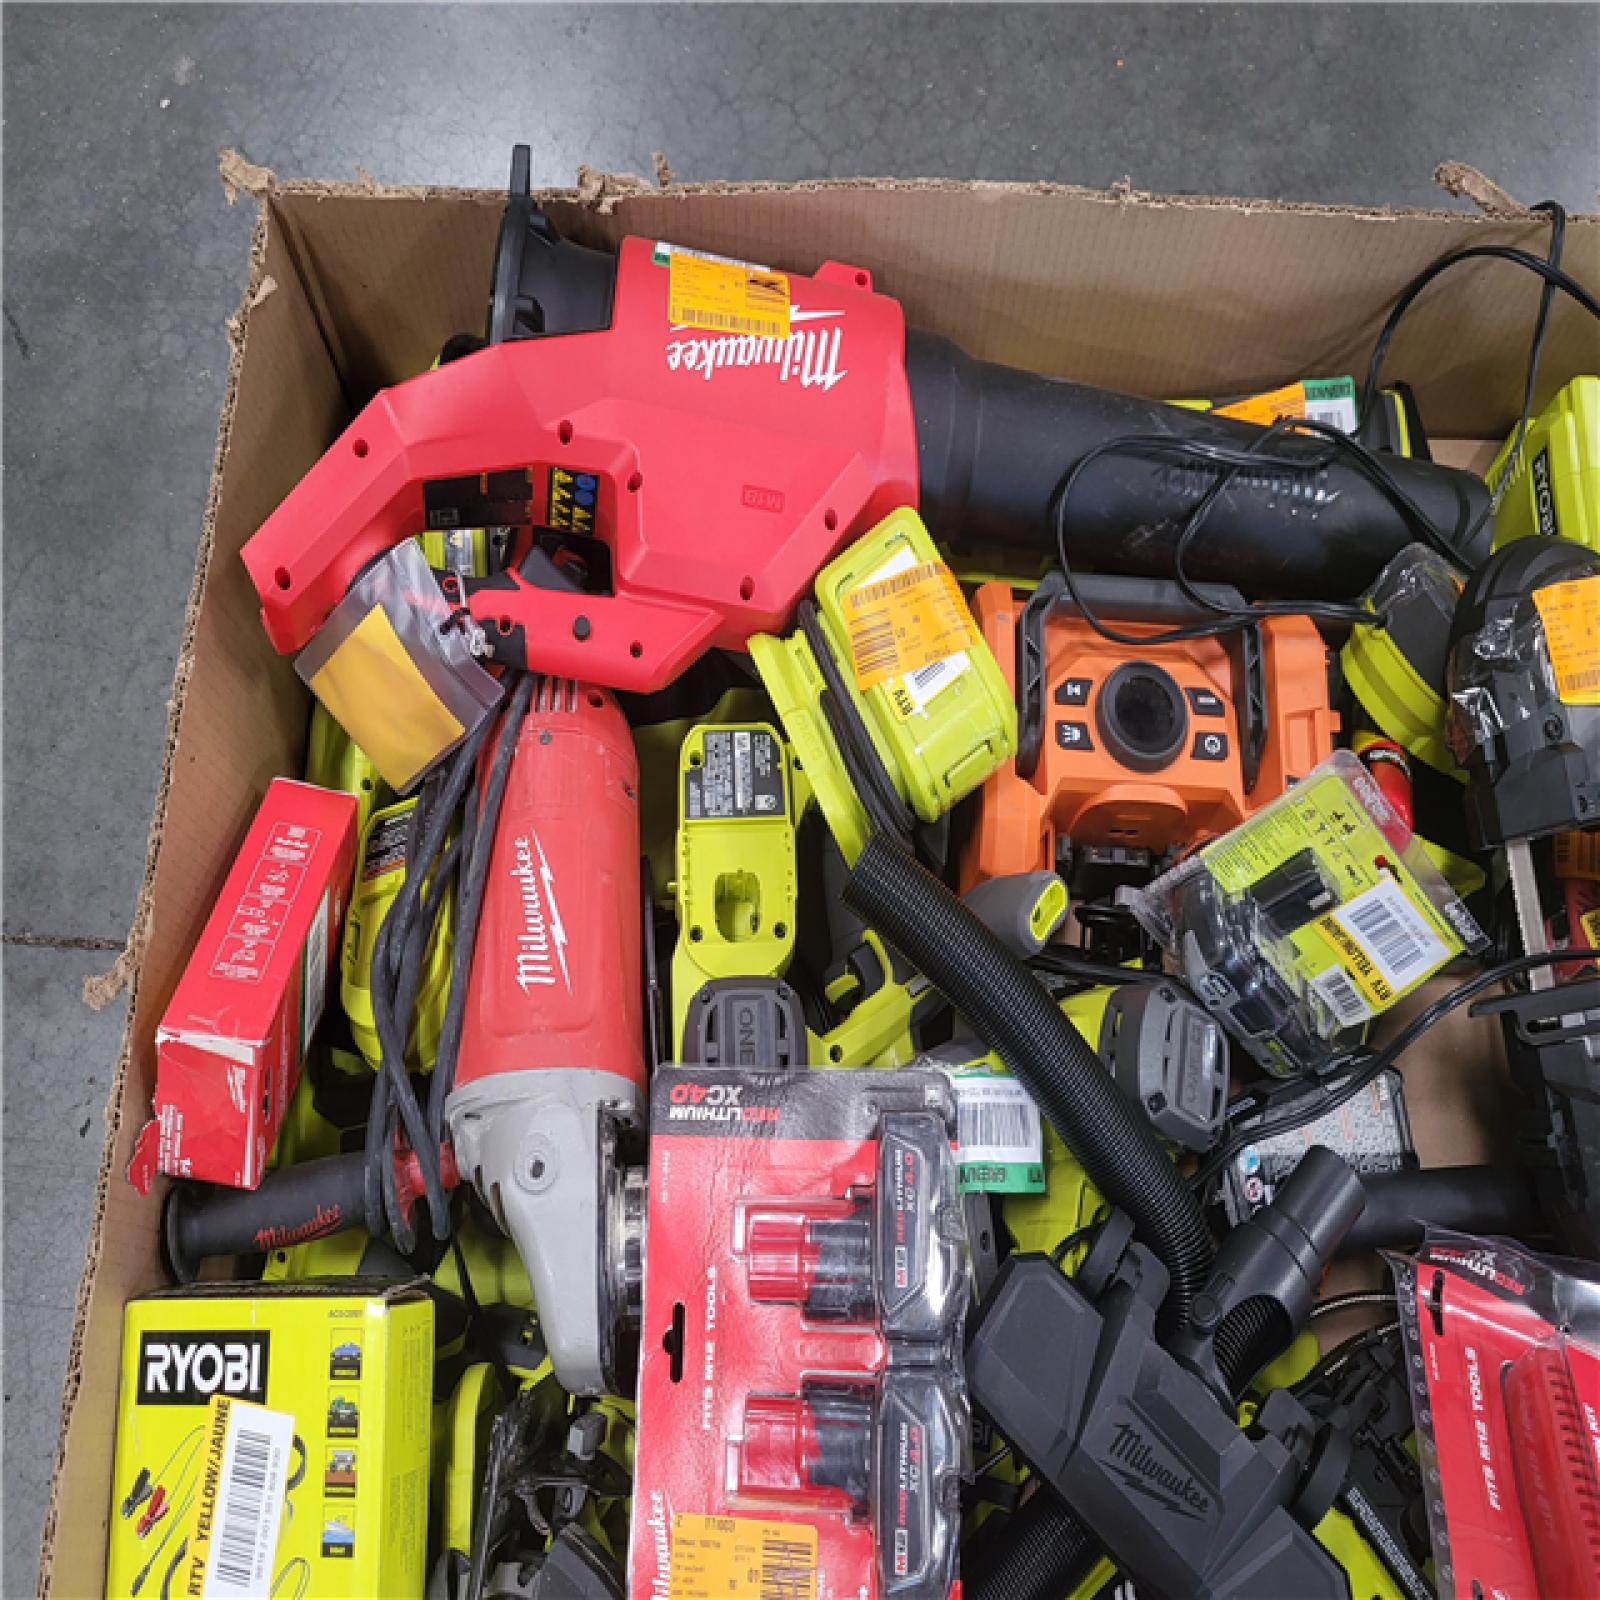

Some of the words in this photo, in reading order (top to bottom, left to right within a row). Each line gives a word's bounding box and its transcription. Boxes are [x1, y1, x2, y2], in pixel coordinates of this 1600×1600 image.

[664, 326, 848, 392] Milwaukee
[1533, 452, 1555, 535] RYOB
[509, 834, 557, 997] Milwaukee
[704, 1264, 718, 1331] TOOLS
[144, 1342, 263, 1394] RYOBI
[1464, 1346, 1483, 1412] TOOLS
[196, 1399, 231, 1542] YELLOW/JAUNE
[1107, 1422, 1209, 1514] Milwaukee
[187, 1555, 206, 1597] RTV
[648, 1489, 671, 1600] ilwaukee
